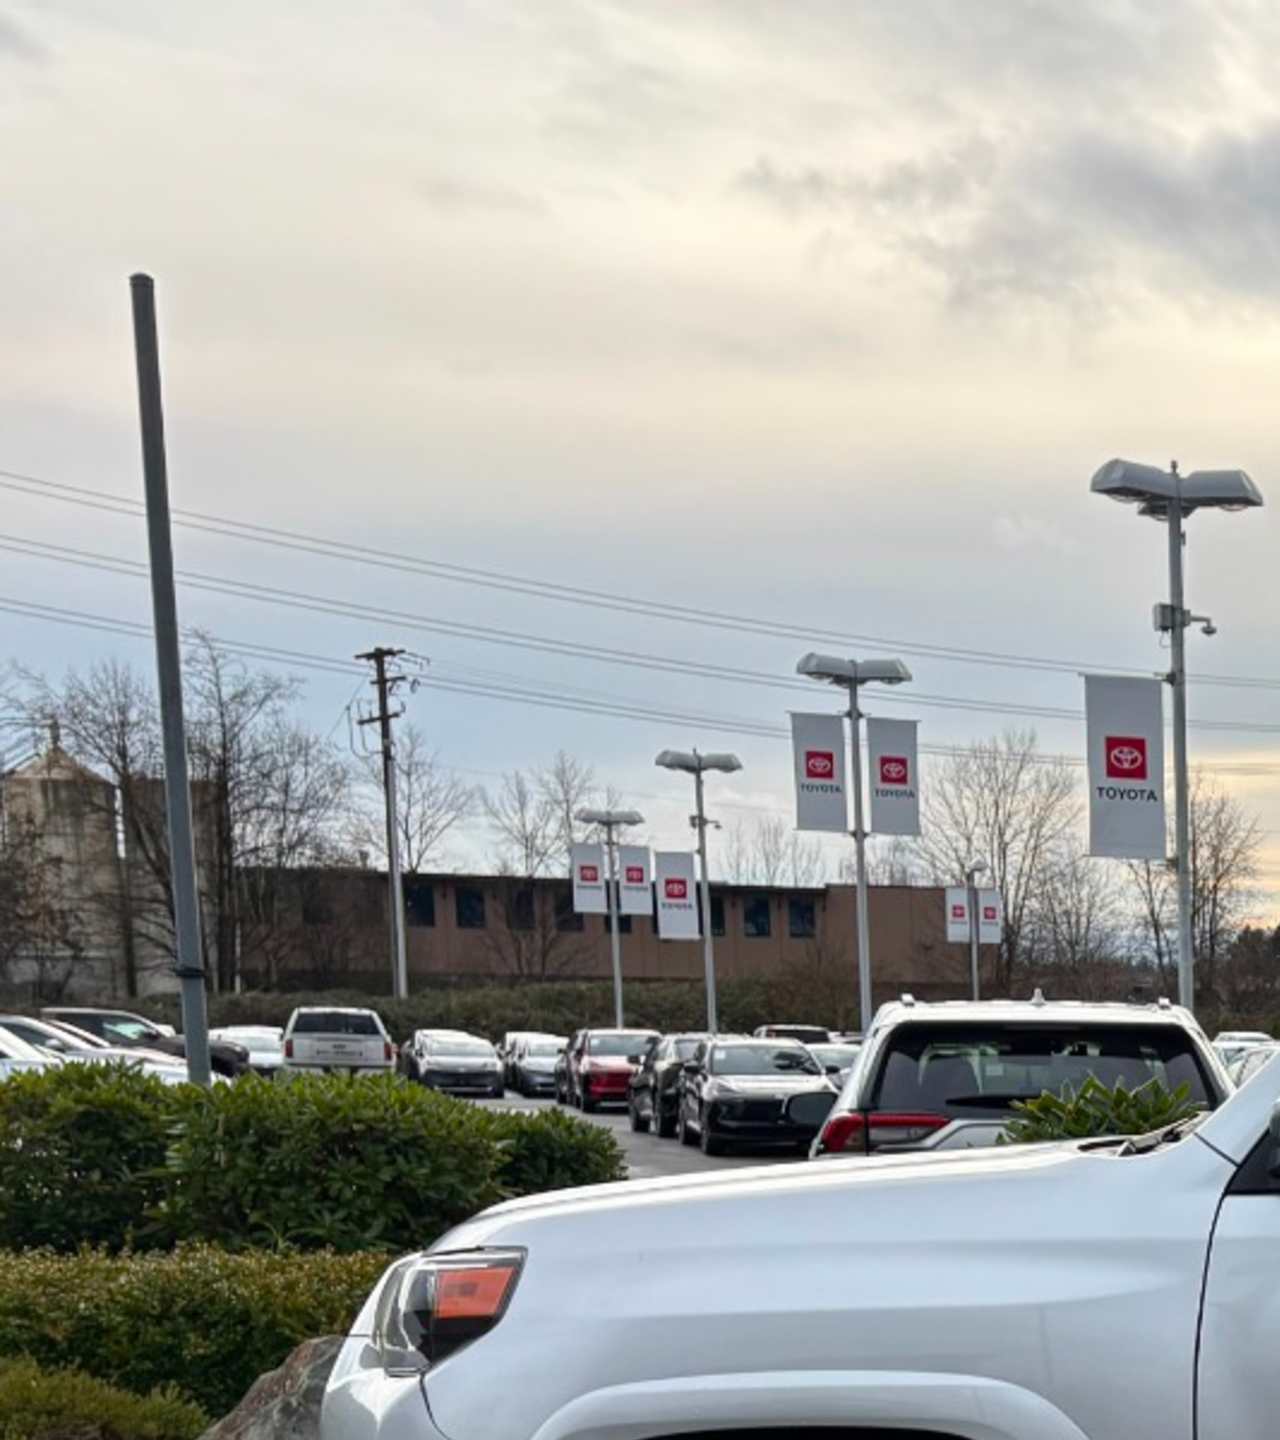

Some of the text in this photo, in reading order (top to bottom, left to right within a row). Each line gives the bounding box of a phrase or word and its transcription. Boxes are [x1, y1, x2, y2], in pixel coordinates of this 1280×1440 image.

[800, 783, 842, 793] TOYOTA
[875, 788, 915, 798] TOYOTA
[1096, 786, 1158, 802] TOYOTA
